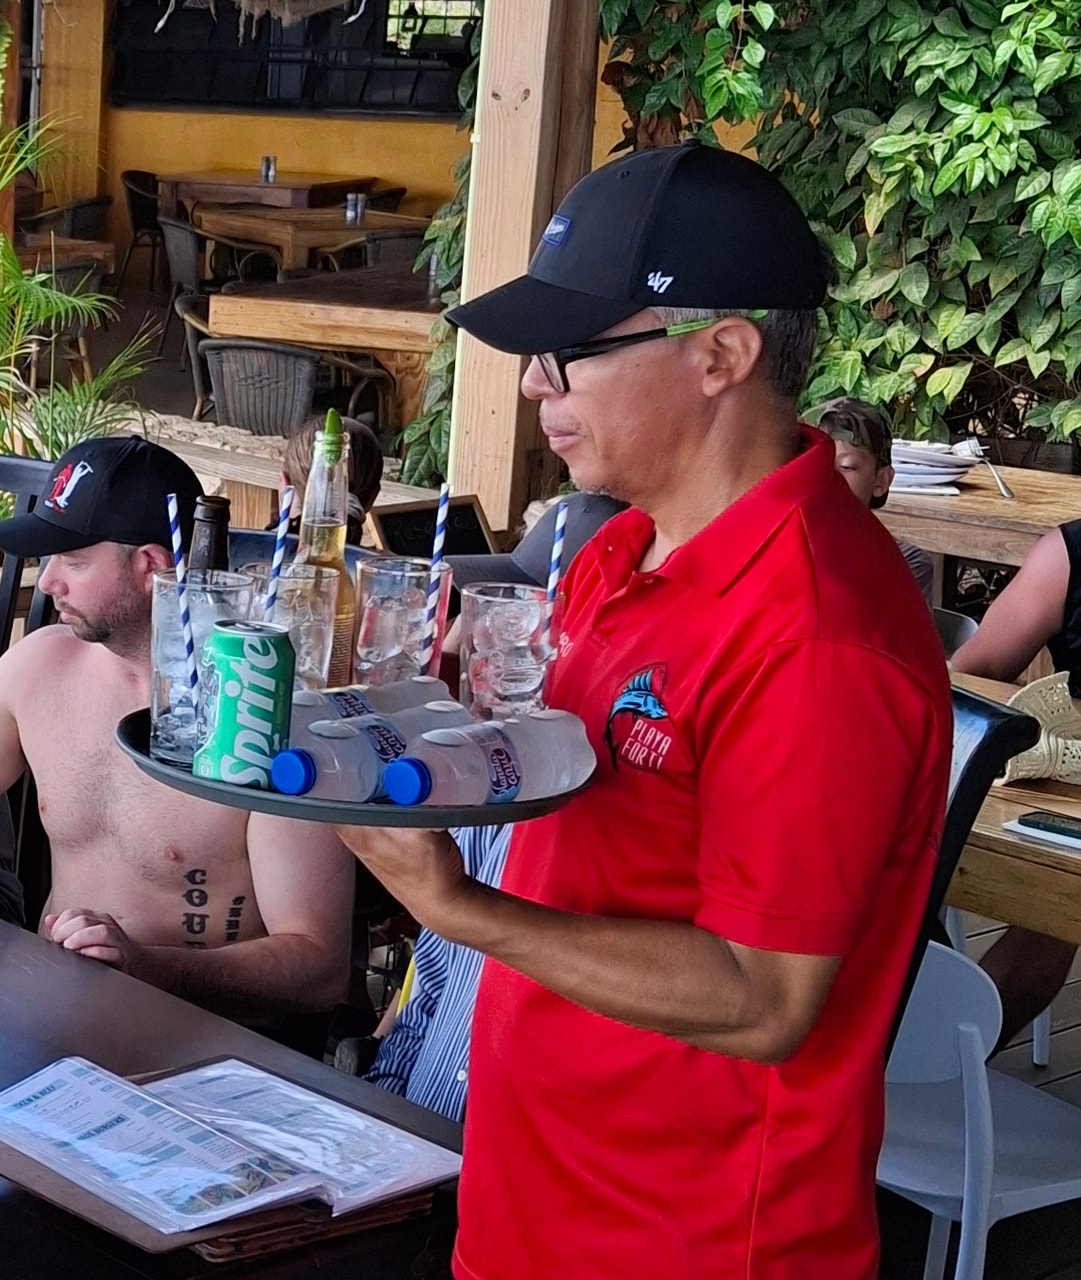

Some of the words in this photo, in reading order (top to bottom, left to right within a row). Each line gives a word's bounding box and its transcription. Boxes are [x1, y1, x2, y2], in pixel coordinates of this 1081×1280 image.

[220, 636, 279, 791] Sprite
[621, 737, 664, 771] FORTI
[630, 719, 672, 756] PLAYA
